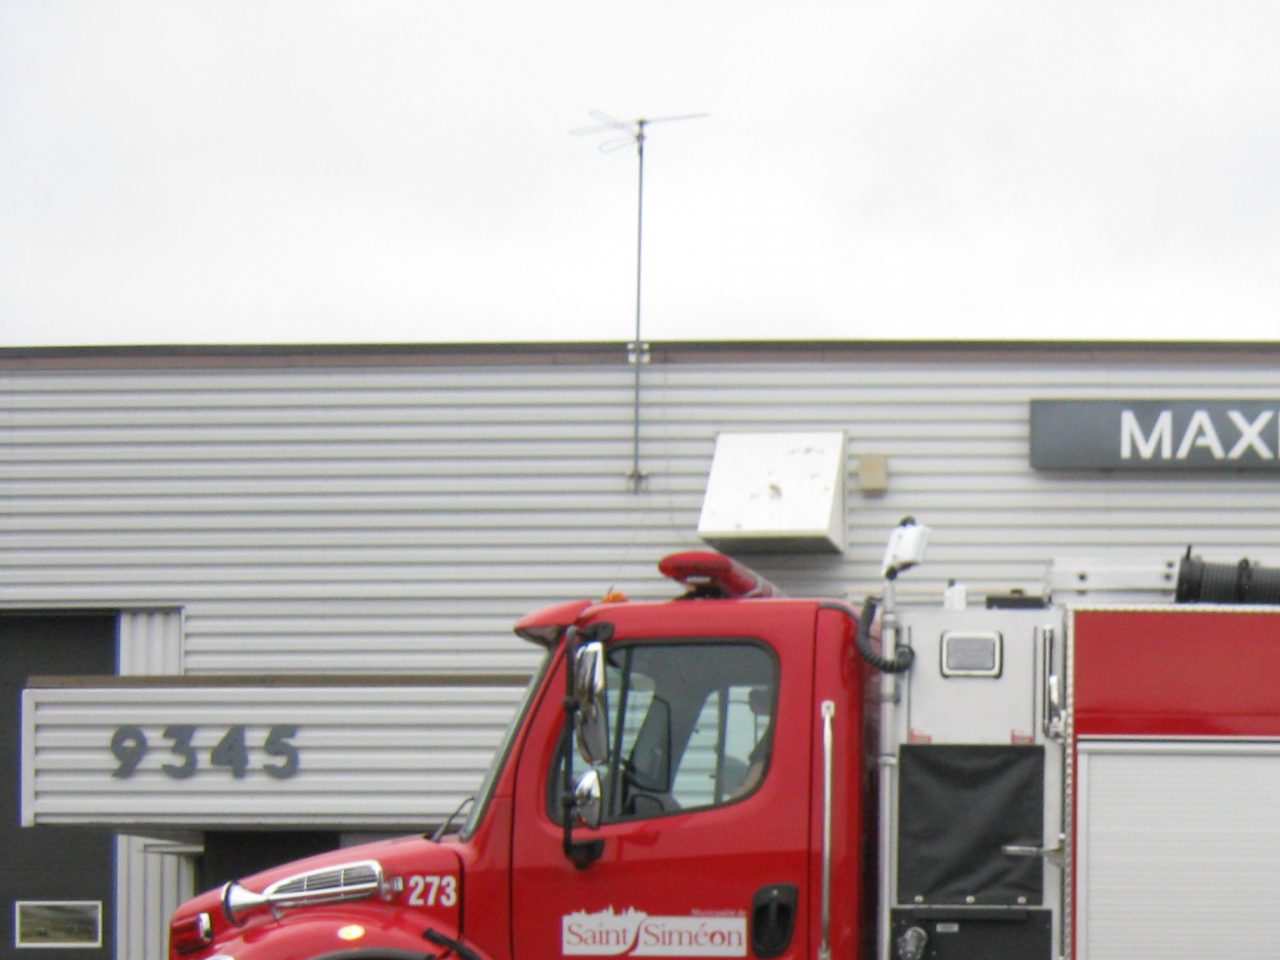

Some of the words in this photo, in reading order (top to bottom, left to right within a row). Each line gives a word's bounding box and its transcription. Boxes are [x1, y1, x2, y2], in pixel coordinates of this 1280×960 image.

[110, 723, 300, 780] 9345
[408, 875, 457, 907] 273
[566, 922, 628, 946] Saint
[643, 921, 743, 947] Siméon
